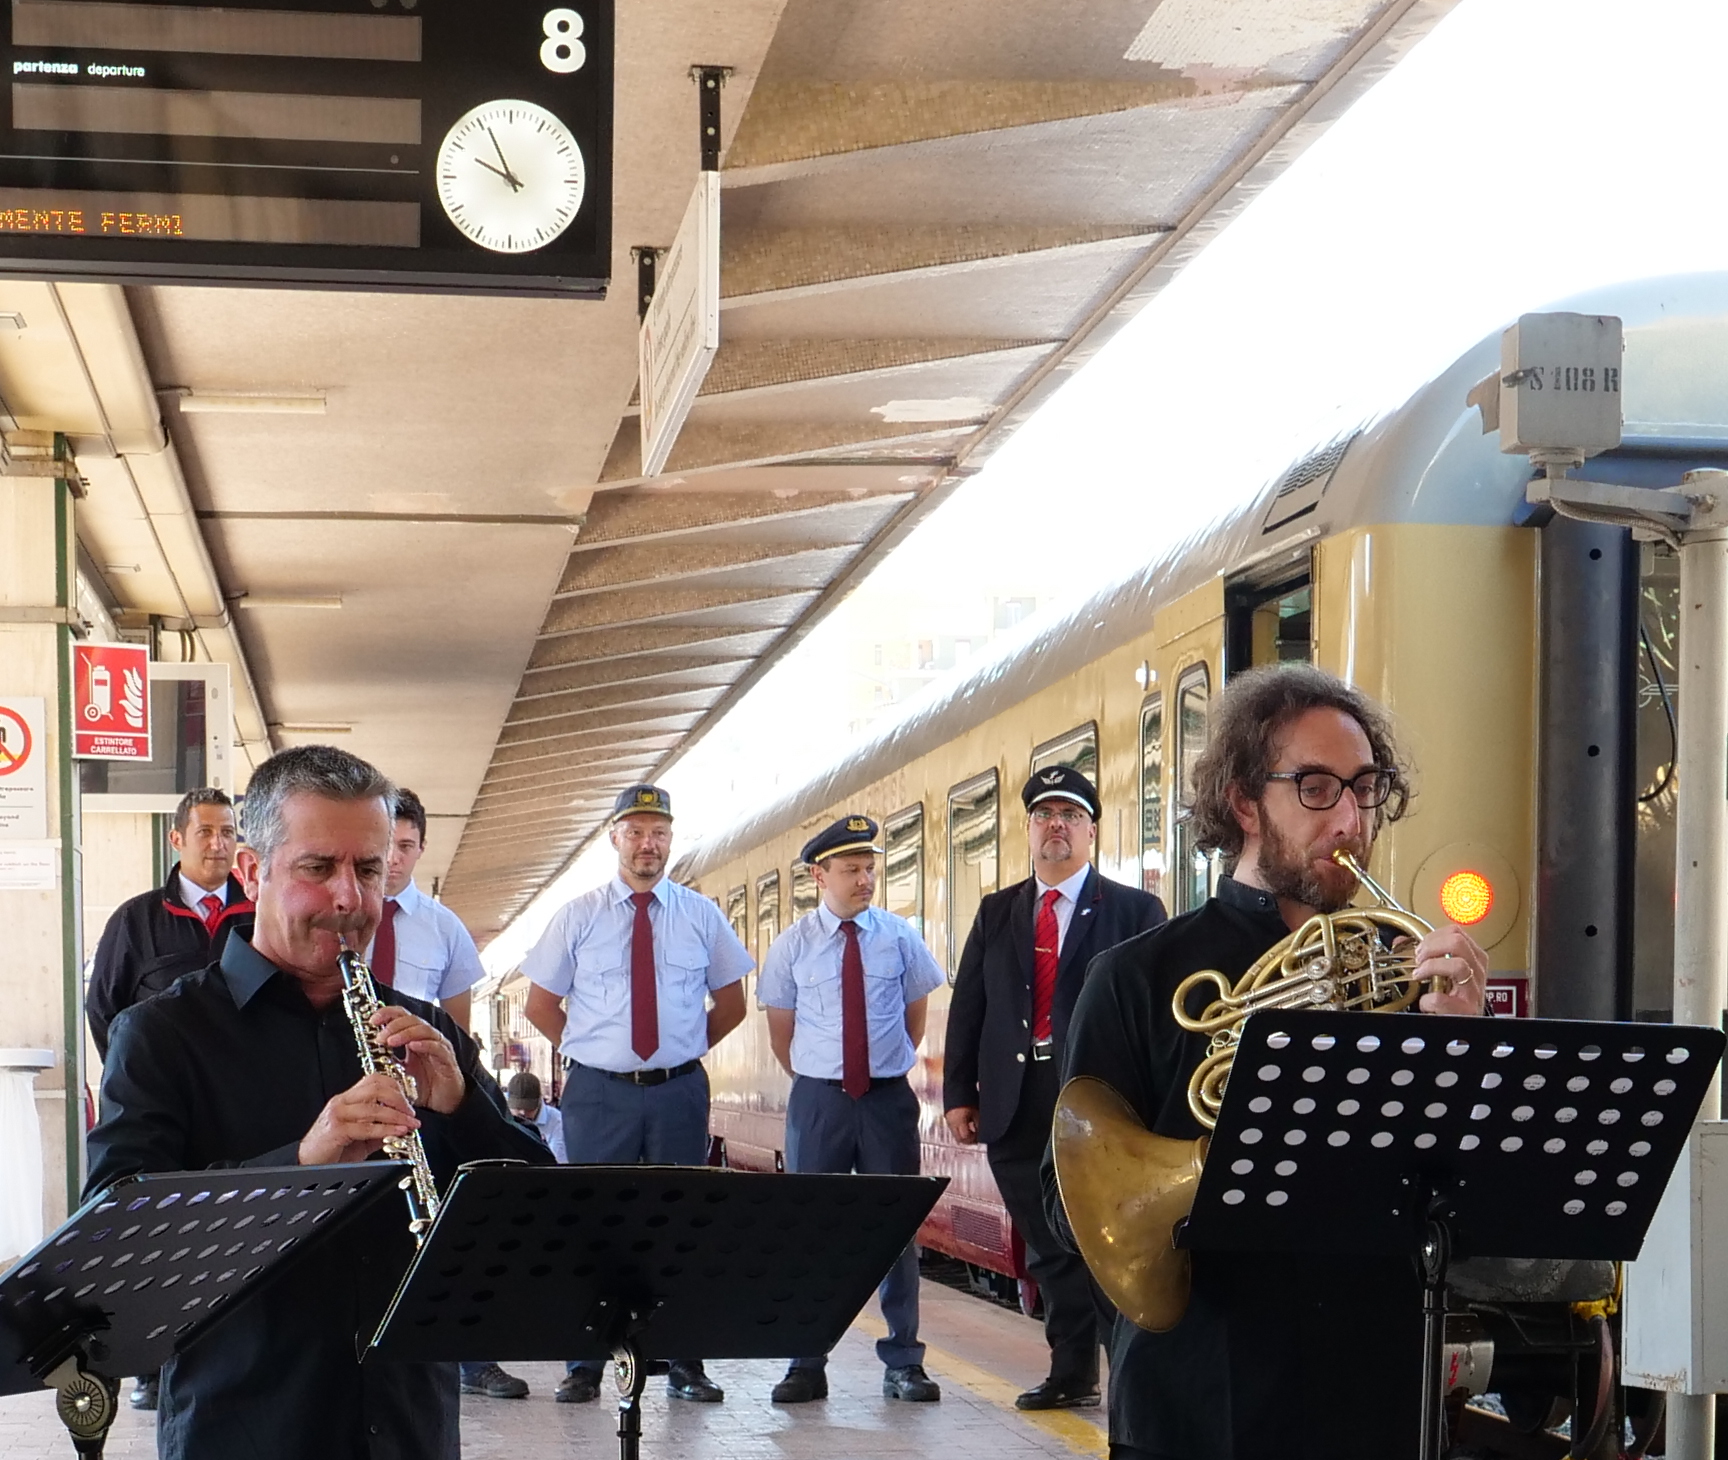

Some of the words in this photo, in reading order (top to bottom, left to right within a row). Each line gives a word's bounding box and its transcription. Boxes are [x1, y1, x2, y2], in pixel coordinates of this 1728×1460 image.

[539, 8, 586, 73] 8
[13, 60, 79, 75] partenza
[87, 62, 145, 77] departure
[101, 212, 183, 236] FERMI
[1603, 367, 1619, 392] R
[90, 745, 138, 755] CARRELLATO
[94, 736, 134, 746] ESTINTORE
